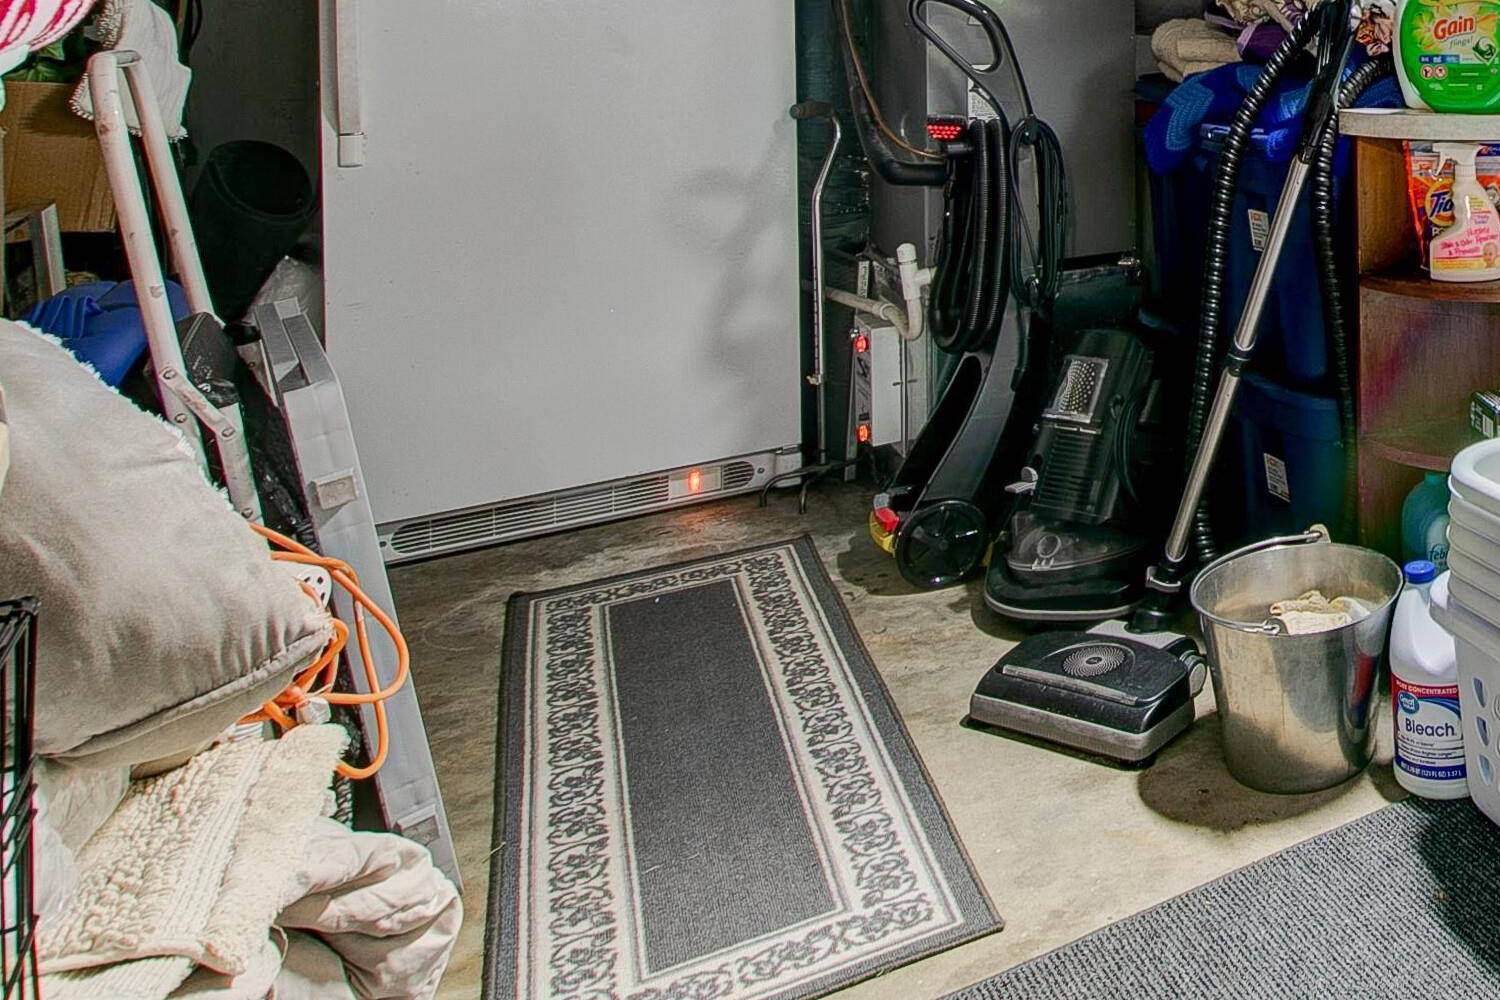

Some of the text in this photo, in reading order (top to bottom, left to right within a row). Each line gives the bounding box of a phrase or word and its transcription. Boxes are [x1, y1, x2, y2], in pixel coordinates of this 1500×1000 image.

[1434, 15, 1475, 40] Gain
[1429, 190, 1455, 218] Tid
[1428, 543, 1449, 562] febr
[1405, 717, 1455, 737] Bleach
